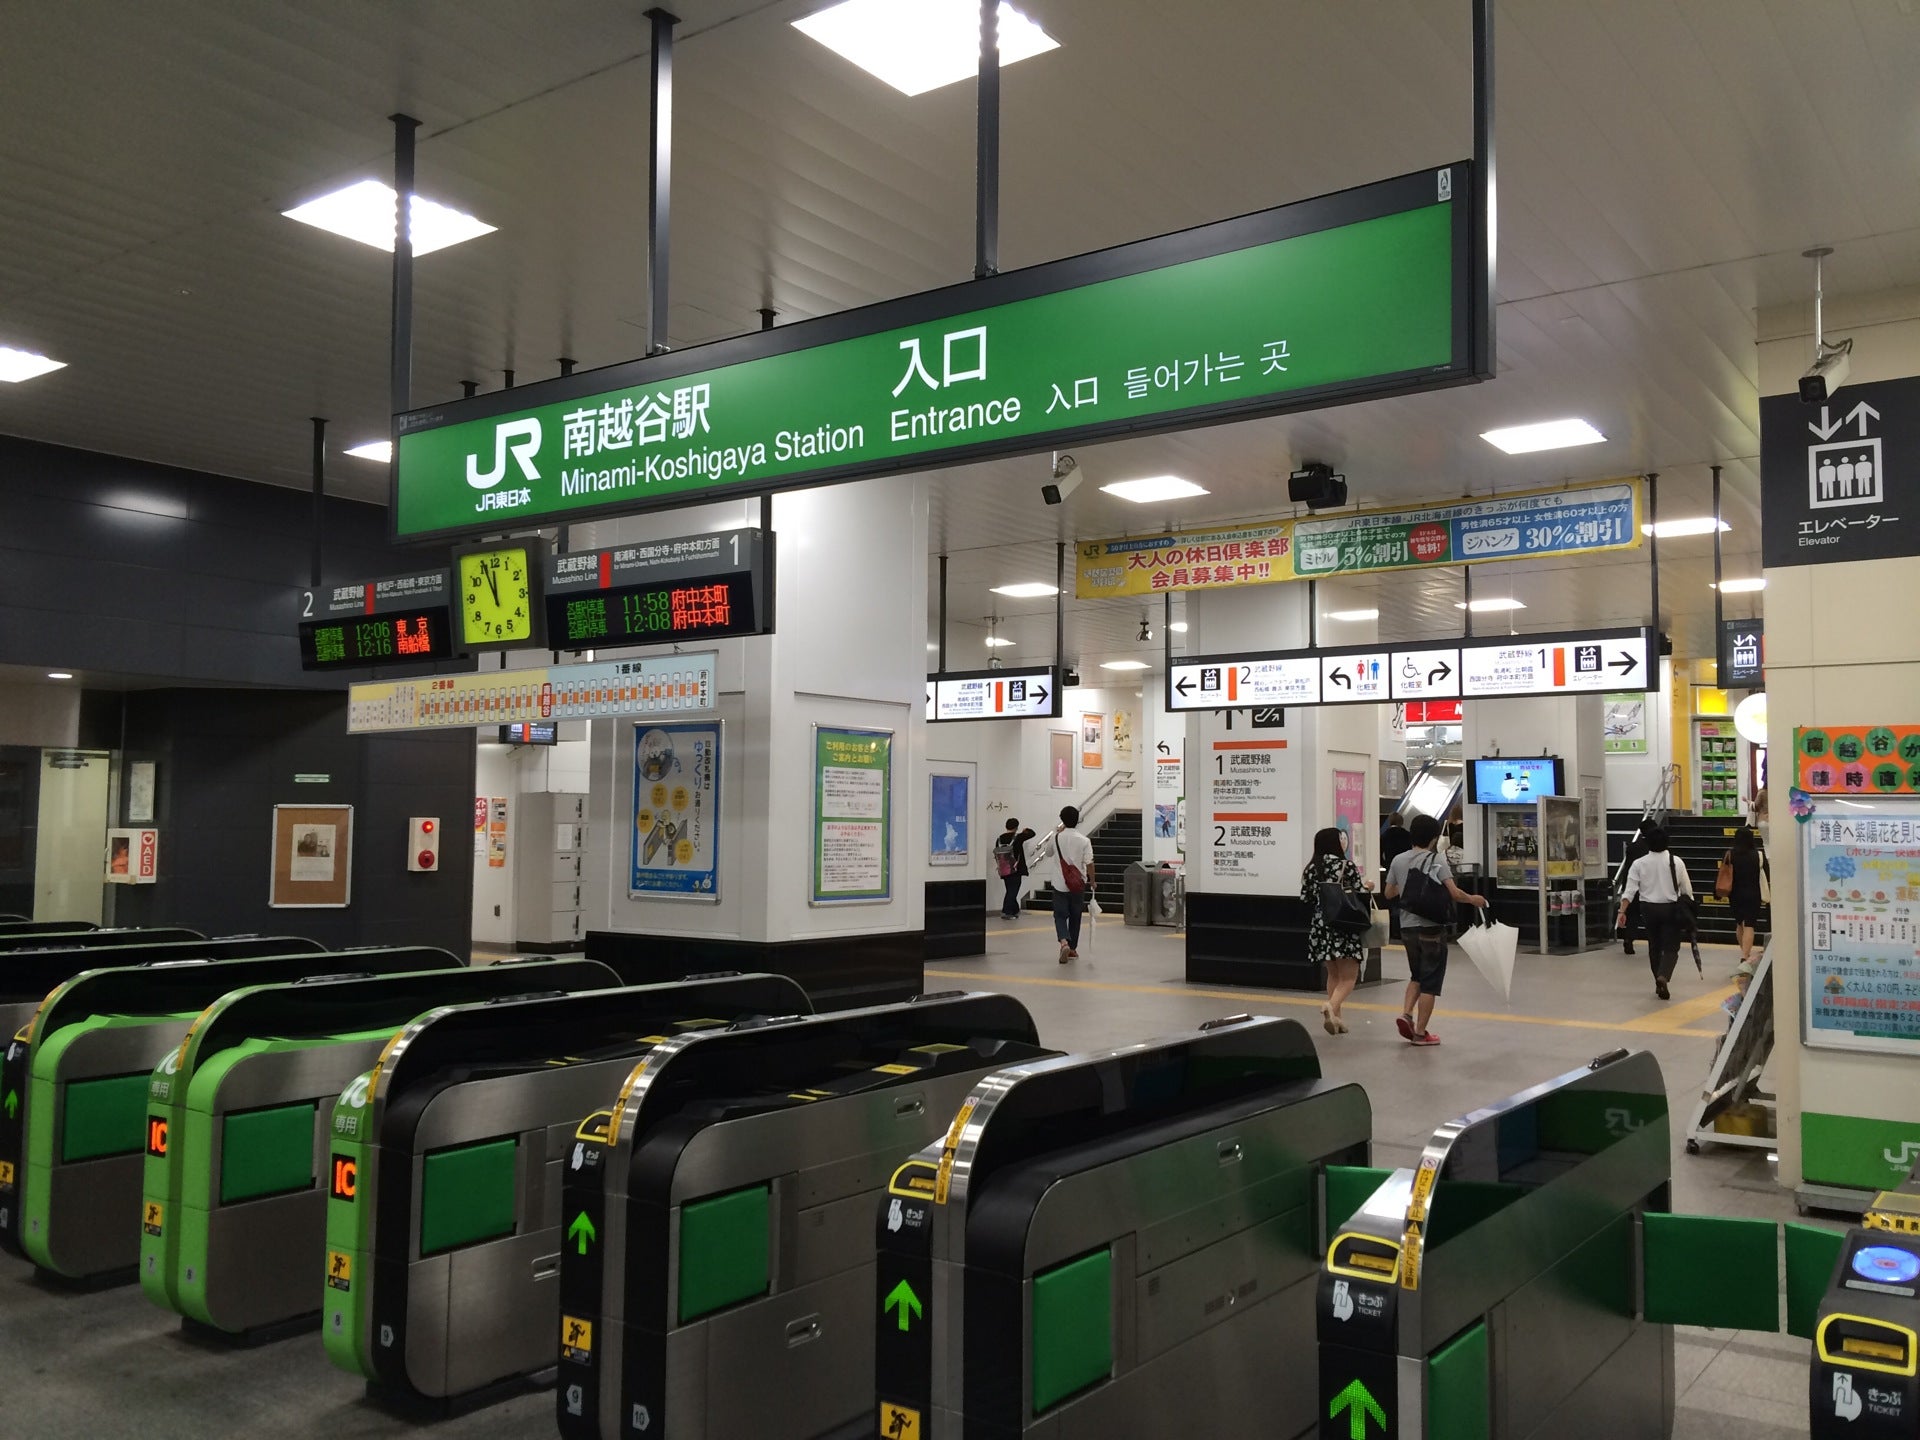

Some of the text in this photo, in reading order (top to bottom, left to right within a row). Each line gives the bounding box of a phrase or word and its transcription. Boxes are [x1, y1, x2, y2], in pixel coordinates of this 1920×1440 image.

[892, 326, 988, 398] 入口
[1124, 339, 1290, 399] 들어가는 곳
[1046, 377, 1098, 414] 入口
[563, 383, 711, 460] 南越谷駅
[891, 397, 1021, 441] Entrance
[466, 417, 542, 489] JR
[561, 424, 864, 497] Minami-Koshigaya Station
[475, 488, 531, 512] JR東日本
[1798, 514, 1899, 534] エレベーター
[1467, 532, 1515, 550] ジパング
[1526, 518, 1622, 549] 30%割引
[1798, 535, 1840, 546] Elevator
[614, 538, 720, 562] 南浦和・西国分寺・府中本町方面
[729, 534, 739, 566] 1
[1084, 545, 1100, 556] JR
[1128, 537, 1289, 569] 大人の休日倶楽部
[1305, 552, 1334, 566] ミドル
[1344, 541, 1409, 566] 5%割引
[490, 558, 500, 568] 12
[557, 555, 598, 573] 武蔵野線
[472, 577, 481, 587] 10
[513, 571, 519, 581] 2
[552, 572, 597, 584] Musashino Line
[1152, 562, 1270, 588] 会員募集中!!
[333, 585, 364, 600] 武蔵野線
[469, 594, 475, 604] 9
[519, 588, 525, 598] 3
[623, 592, 669, 614] 11:58
[672, 585, 728, 610] 府中本町
[303, 592, 313, 617] 2
[514, 607, 521, 617] 4
[475, 611, 481, 621] 8
[507, 620, 513, 630] 5
[624, 612, 671, 633] 12:08
[673, 606, 731, 630] 府中本町
[356, 622, 390, 641] 12:06
[485, 622, 491, 632] 7
[496, 625, 502, 634] 6
[357, 639, 391, 657] 12:16
[397, 634, 430, 654] 南船橋
[1538, 649, 1545, 668] 1
[615, 663, 642, 674] 1番線
[1241, 666, 1251, 684] 2
[986, 682, 991, 699] 1
[1215, 755, 1223, 775] 1
[1230, 754, 1271, 765] 武蔵野線
[1157, 765, 1163, 775] 2
[1214, 826, 1226, 846] 2
[1230, 826, 1271, 837] 武蔵野線
[1263, 838, 1276, 846] Line
[142, 846, 152, 876] AED
[1817, 914, 1827, 947] 南越谷駅
[151, 1081, 168, 1098] 専用
[335, 1115, 358, 1135] 専用
[151, 1121, 167, 1153] IC
[336, 1160, 356, 1196] IC
[1358, 1293, 1383, 1308] きっぷ
[1358, 1306, 1382, 1317] TICKET
[1867, 1388, 1902, 1405] きっぷ
[634, 1411, 645, 1426] 10
[1867, 1403, 1901, 1416] TICKET
